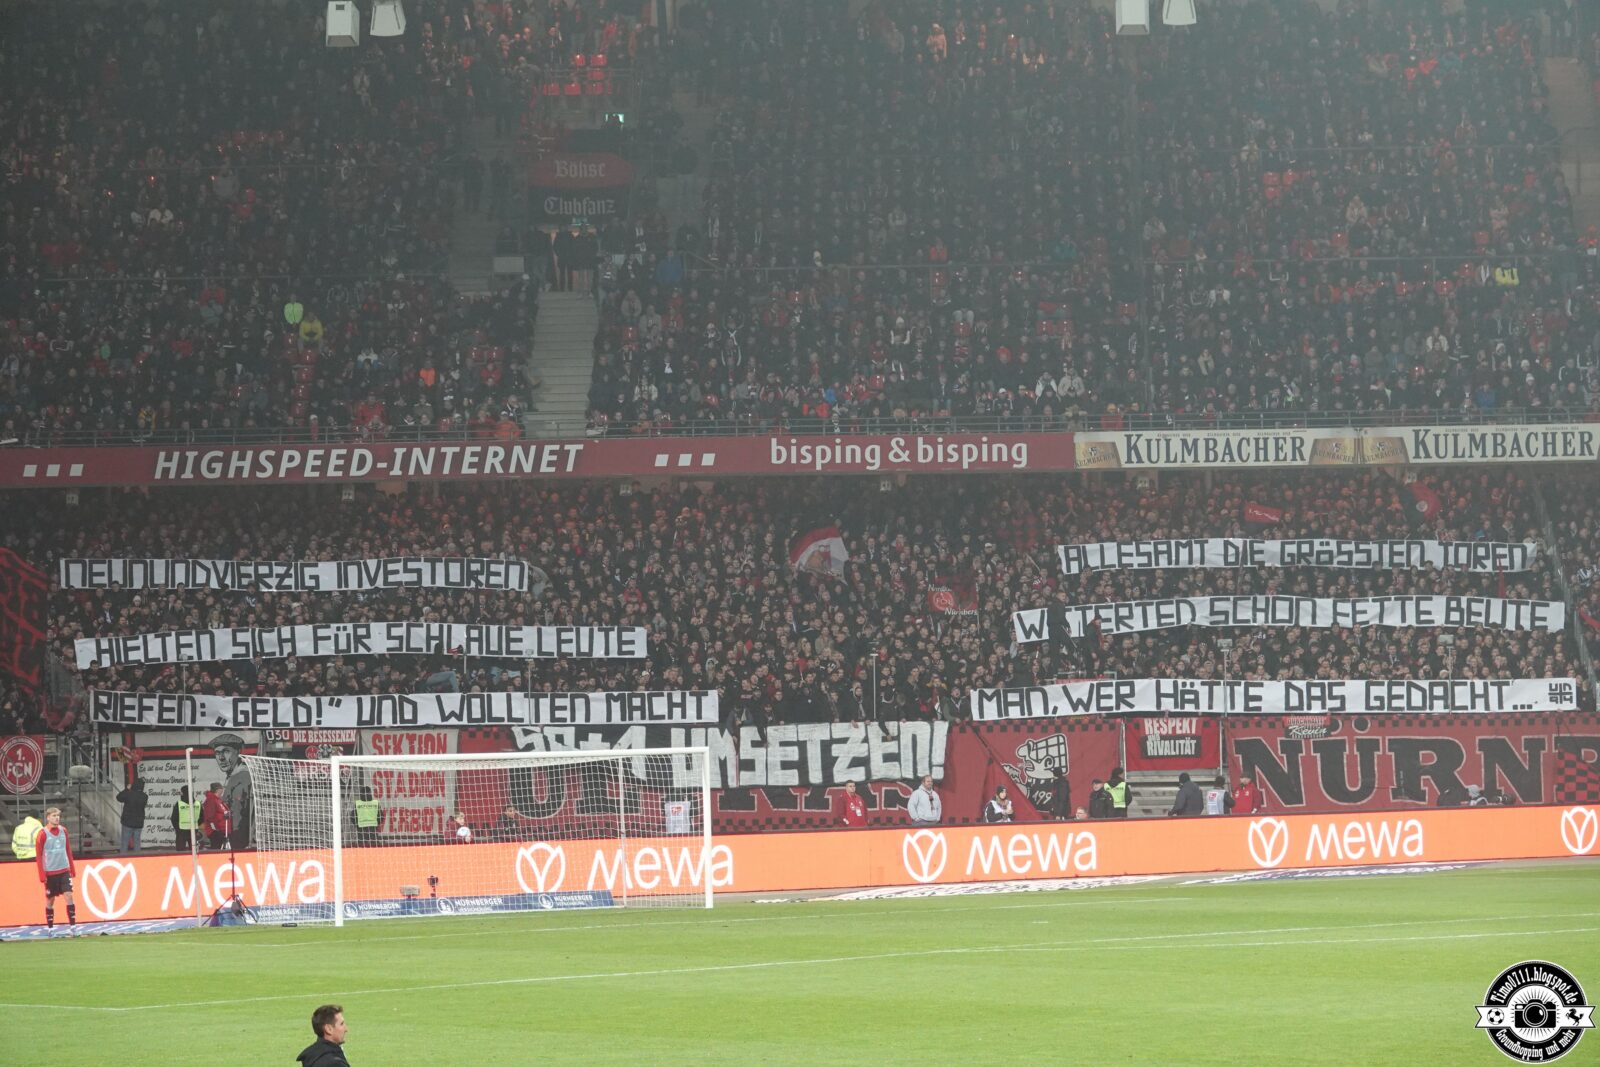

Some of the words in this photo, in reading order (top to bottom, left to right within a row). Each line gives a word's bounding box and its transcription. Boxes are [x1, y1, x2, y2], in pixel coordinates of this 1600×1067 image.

[771, 437, 881, 470] bisping
[888, 437, 911, 463] &
[917, 436, 1028, 469] bisping
[1124, 433, 1306, 464] KULMBACHER
[1412, 428, 1594, 459] KULMBACHER
[154, 444, 584, 479] HIGHSPEED-INTERNET
[1066, 540, 1209, 572] ALLESAMT
[1223, 539, 1265, 566] DIE
[1280, 540, 1425, 568] GRÖSSTEN
[1439, 541, 1527, 571] TOREN
[64, 559, 319, 590] NEUNUNDVIERZIG
[336, 557, 525, 590] INVESTOREN
[1209, 596, 1317, 625] SCHON
[1332, 596, 1435, 627] FETTE
[1445, 596, 1550, 632] BEUTE
[95, 630, 216, 664] HIELTEN
[232, 626, 297, 658] SICH
[313, 624, 372, 654] FÜR
[537, 625, 636, 657] LEUTE
[94, 691, 206, 726] RIEFEN:
[357, 695, 418, 727] UND
[436, 692, 590, 724] WOLLTEN
[606, 691, 708, 721] MACHT
[1156, 680, 1264, 711] HÄTTE
[1284, 682, 1346, 712] DAS
[293, 730, 307, 742] DIE
[309, 730, 356, 742] BESESSENEN
[1144, 717, 1198, 735] RESPEKT
[671, 721, 948, 789] UMSETZEN!
[1146, 736, 1196, 755] RIVALITÄT
[7, 762, 32, 778] FCN
[372, 770, 446, 799] STADION
[376, 806, 444, 834] VERBOT
